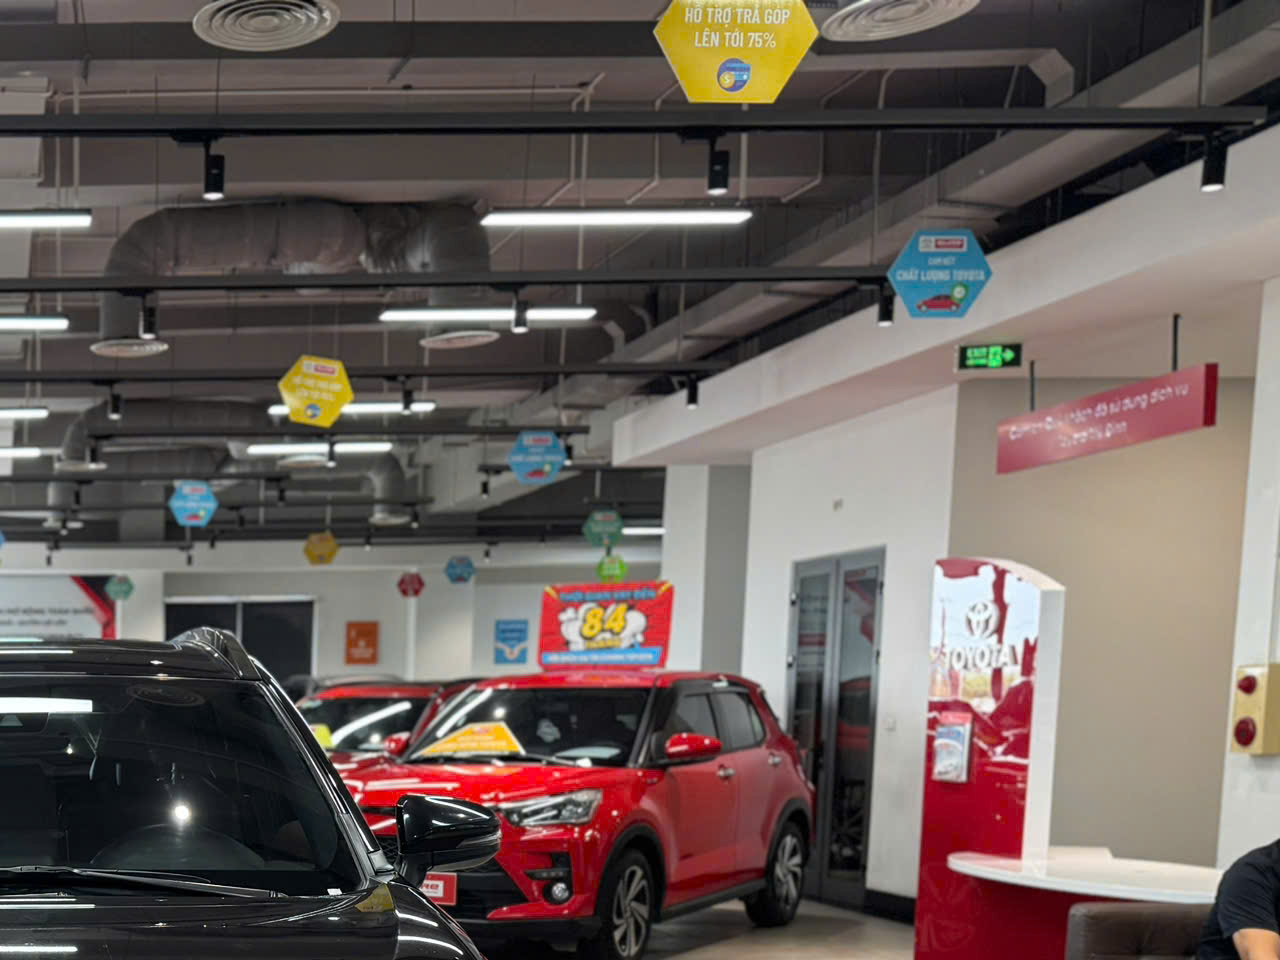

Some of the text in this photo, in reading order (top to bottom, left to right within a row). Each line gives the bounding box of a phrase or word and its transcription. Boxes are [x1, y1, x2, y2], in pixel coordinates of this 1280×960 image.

[694, 27, 776, 48] LÊN TỚI 75%
[580, 603, 628, 639] 84
[942, 643, 1020, 671] TOYOTA
